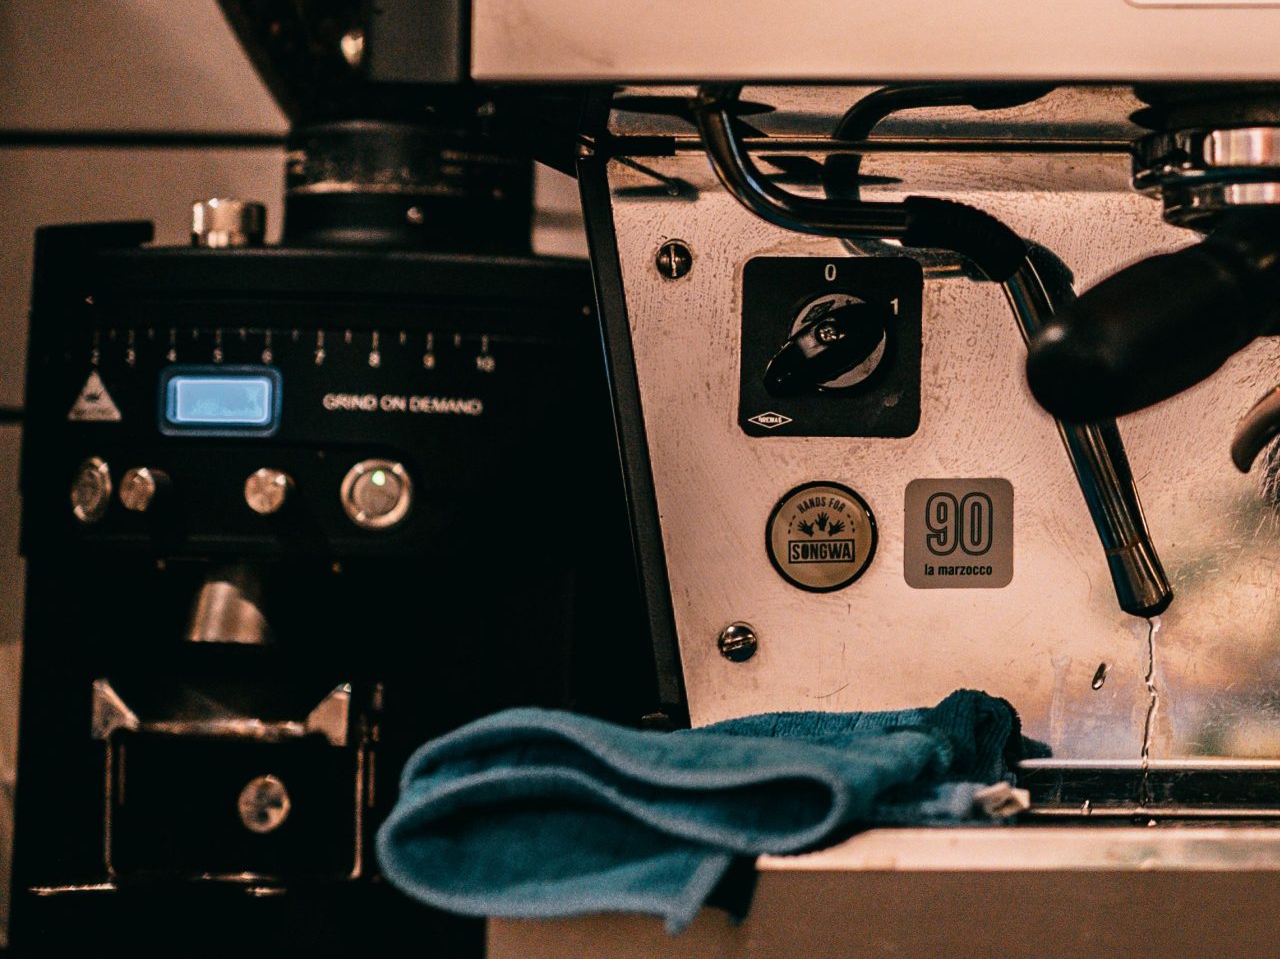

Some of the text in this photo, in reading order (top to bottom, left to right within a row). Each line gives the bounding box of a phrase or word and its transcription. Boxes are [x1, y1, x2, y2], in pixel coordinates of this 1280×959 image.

[824, 263, 837, 282] 0
[889, 297, 900, 315] 1
[323, 393, 483, 416] GRIND ON DEMAND
[796, 496, 847, 514] HANDS FOR
[925, 491, 994, 556] 90
[792, 542, 852, 560] SONGWA
[924, 562, 993, 576] la marzocco
